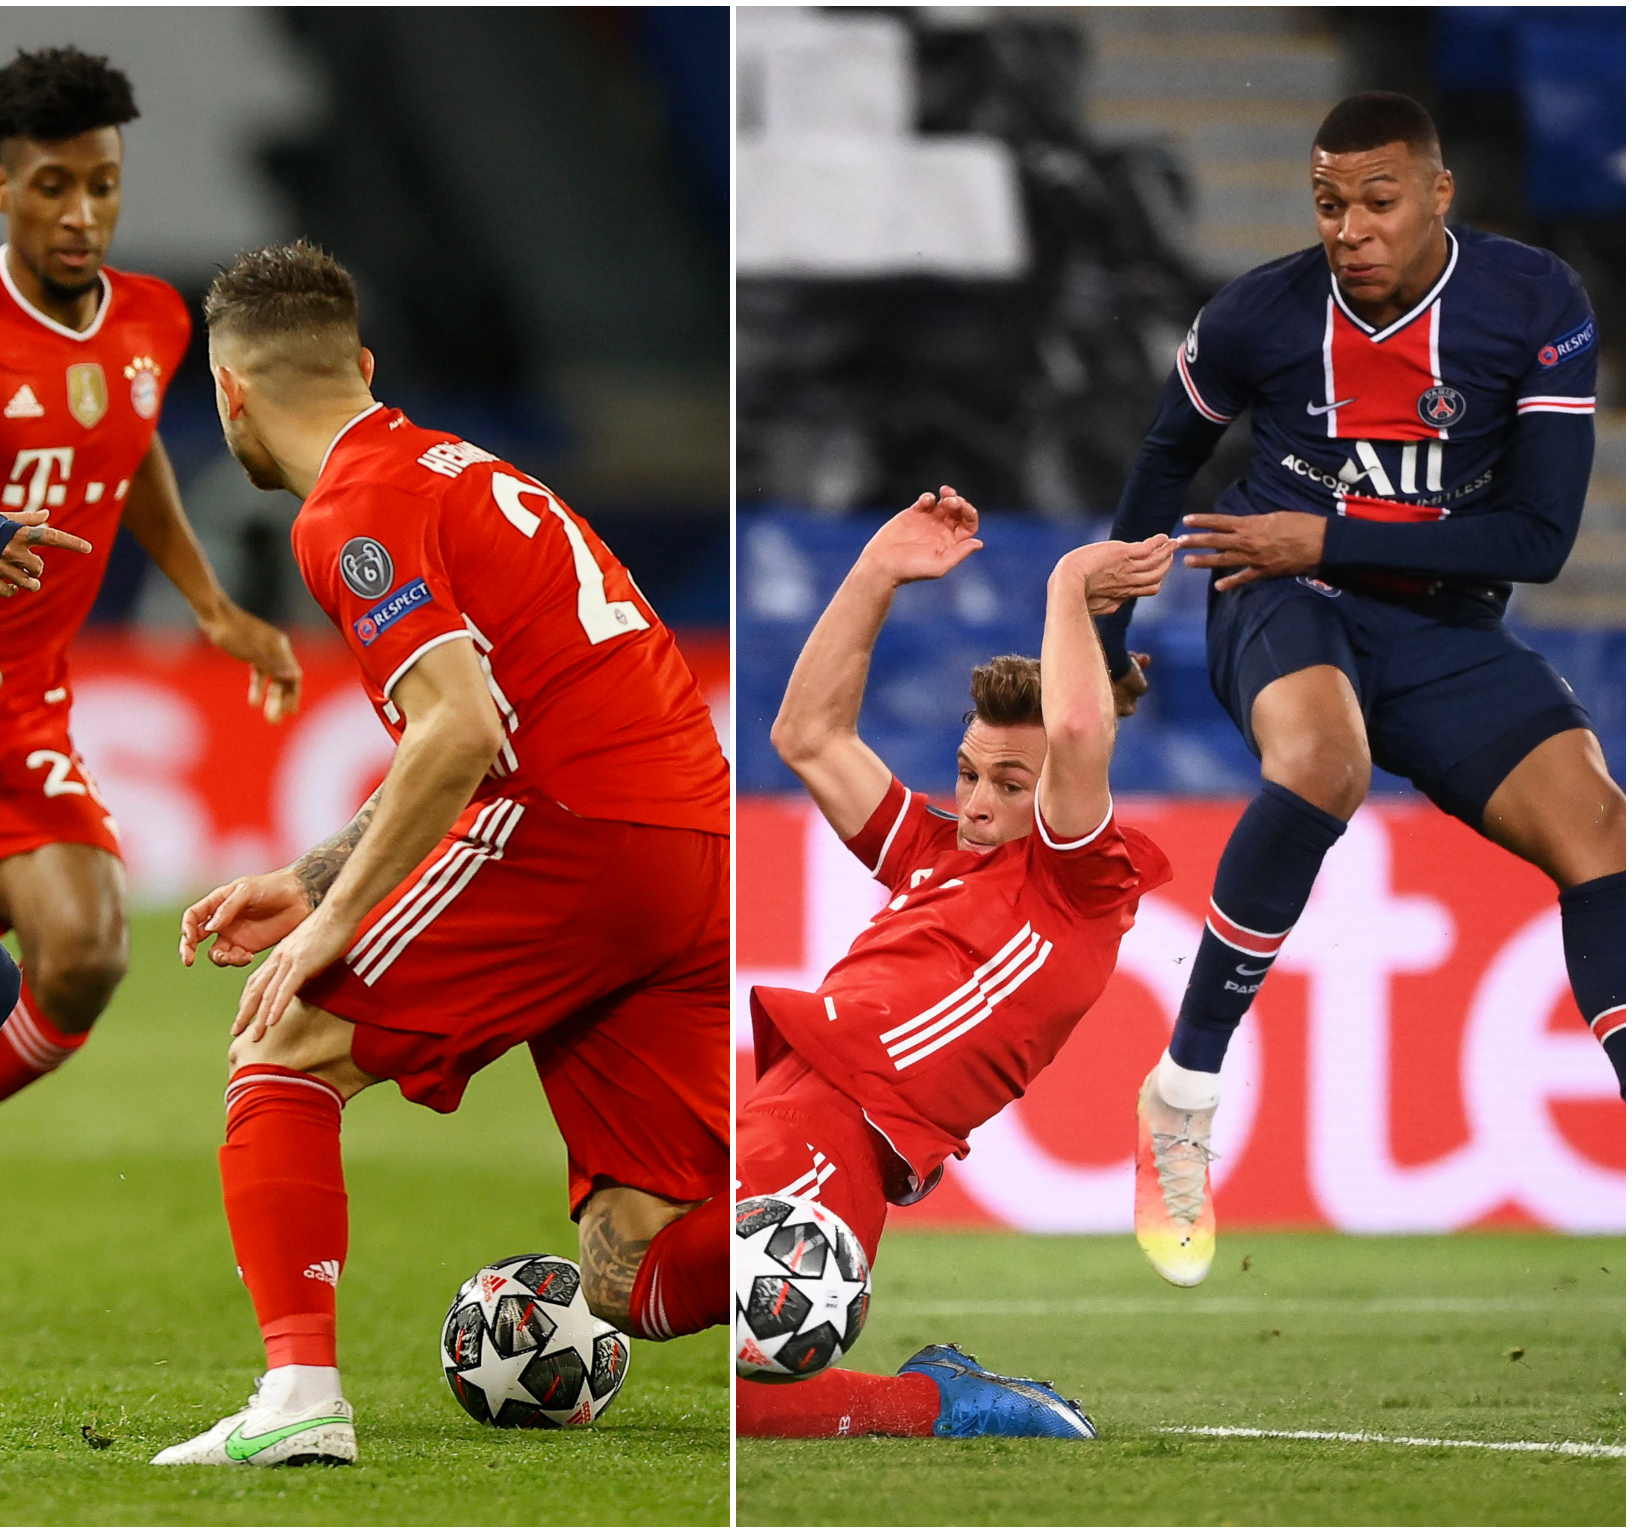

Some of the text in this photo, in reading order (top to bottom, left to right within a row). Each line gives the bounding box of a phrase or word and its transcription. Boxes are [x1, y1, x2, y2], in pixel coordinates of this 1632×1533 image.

[1281, 453, 1350, 495] ACCOR
[491, 470, 656, 645] 2
[373, 582, 428, 626] RESPECT
